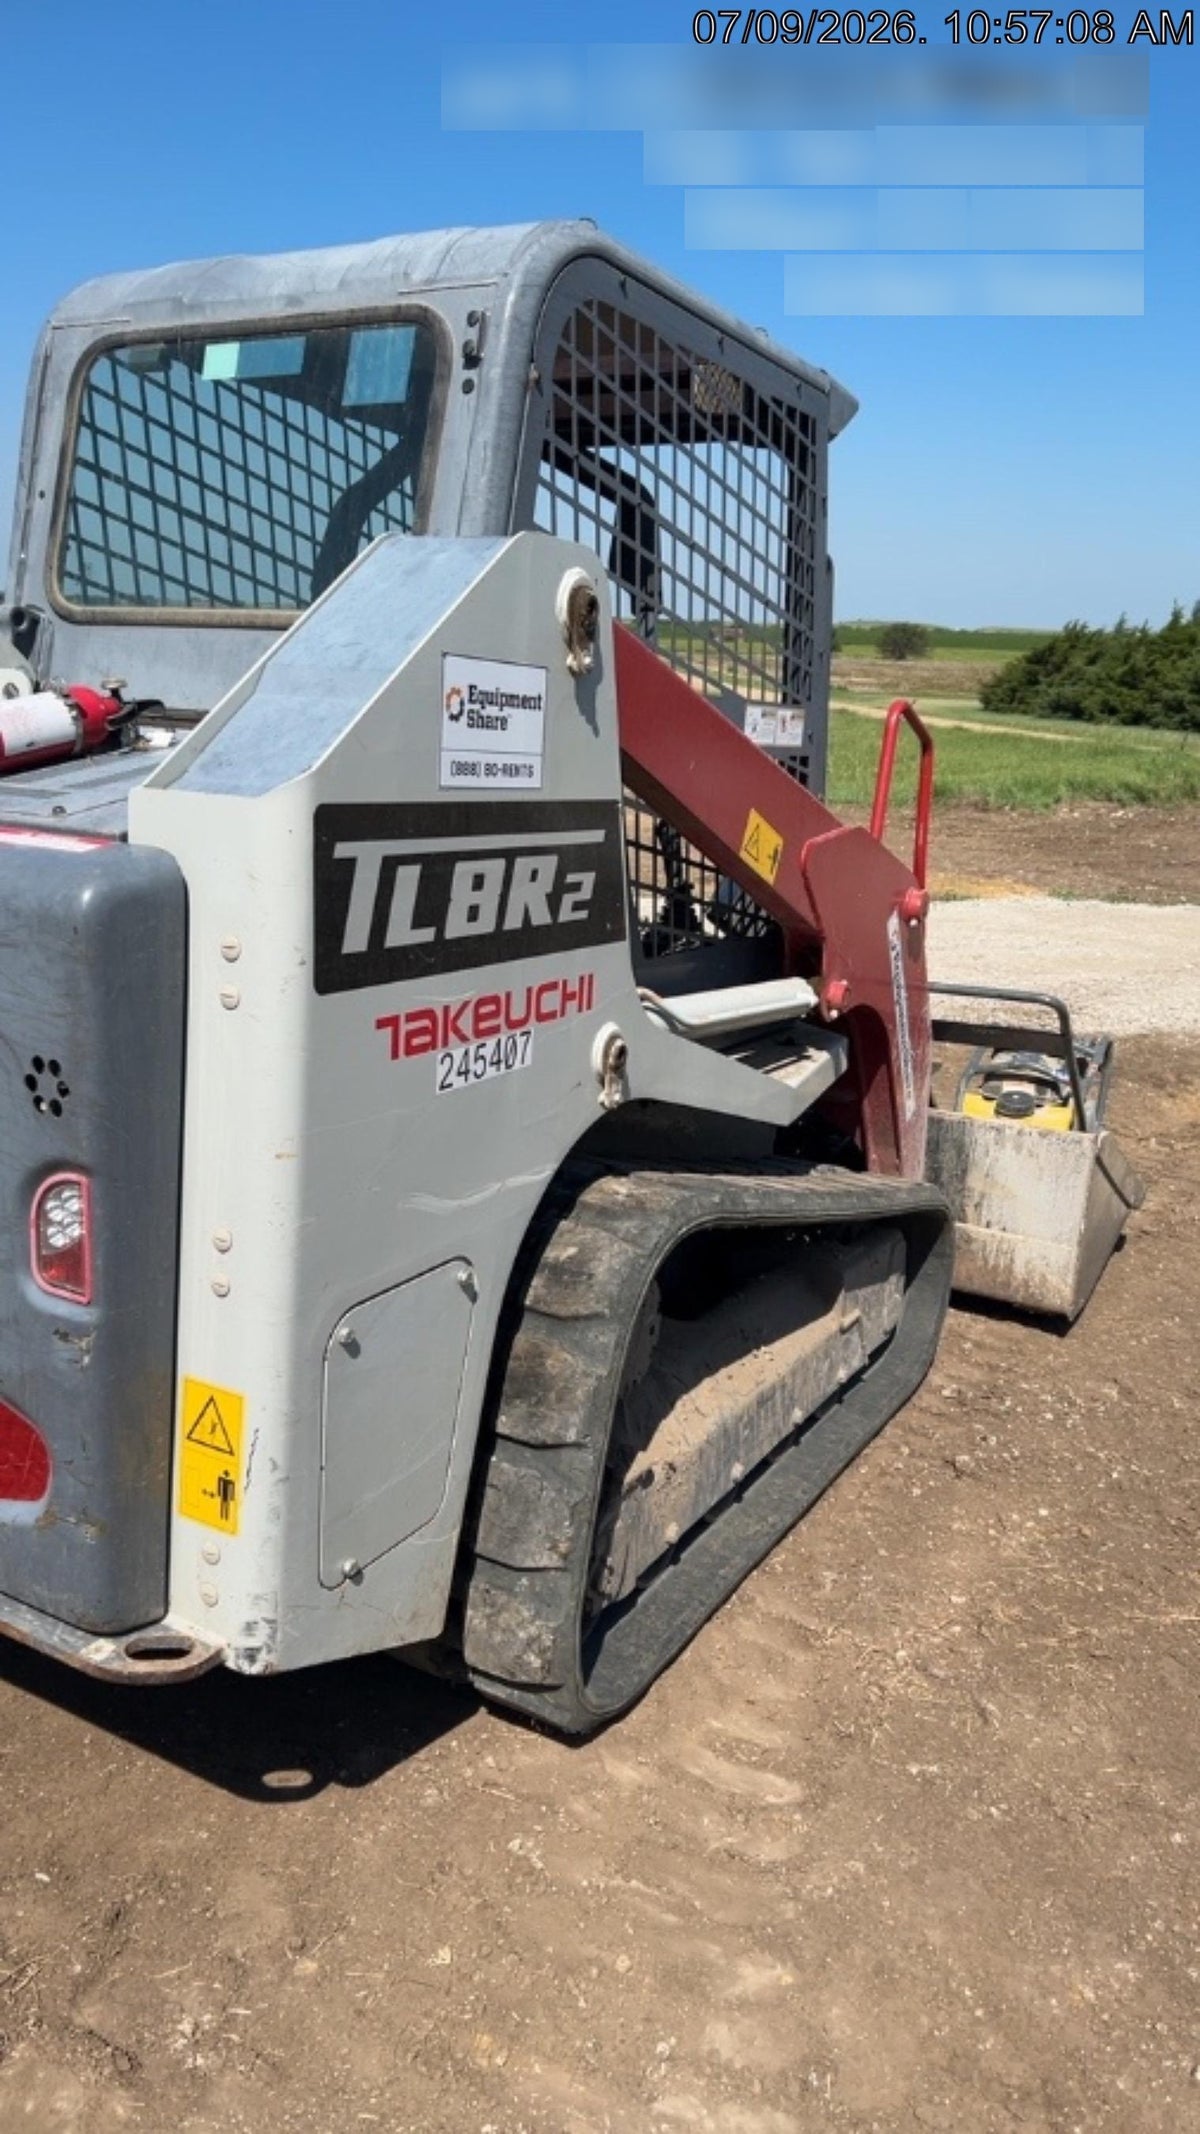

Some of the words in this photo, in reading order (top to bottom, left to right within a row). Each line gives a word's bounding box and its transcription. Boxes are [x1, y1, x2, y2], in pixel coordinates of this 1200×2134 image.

[468, 684, 542, 712] Equipment
[467, 708, 508, 731] Share
[438, 1031, 533, 1092] 245407
